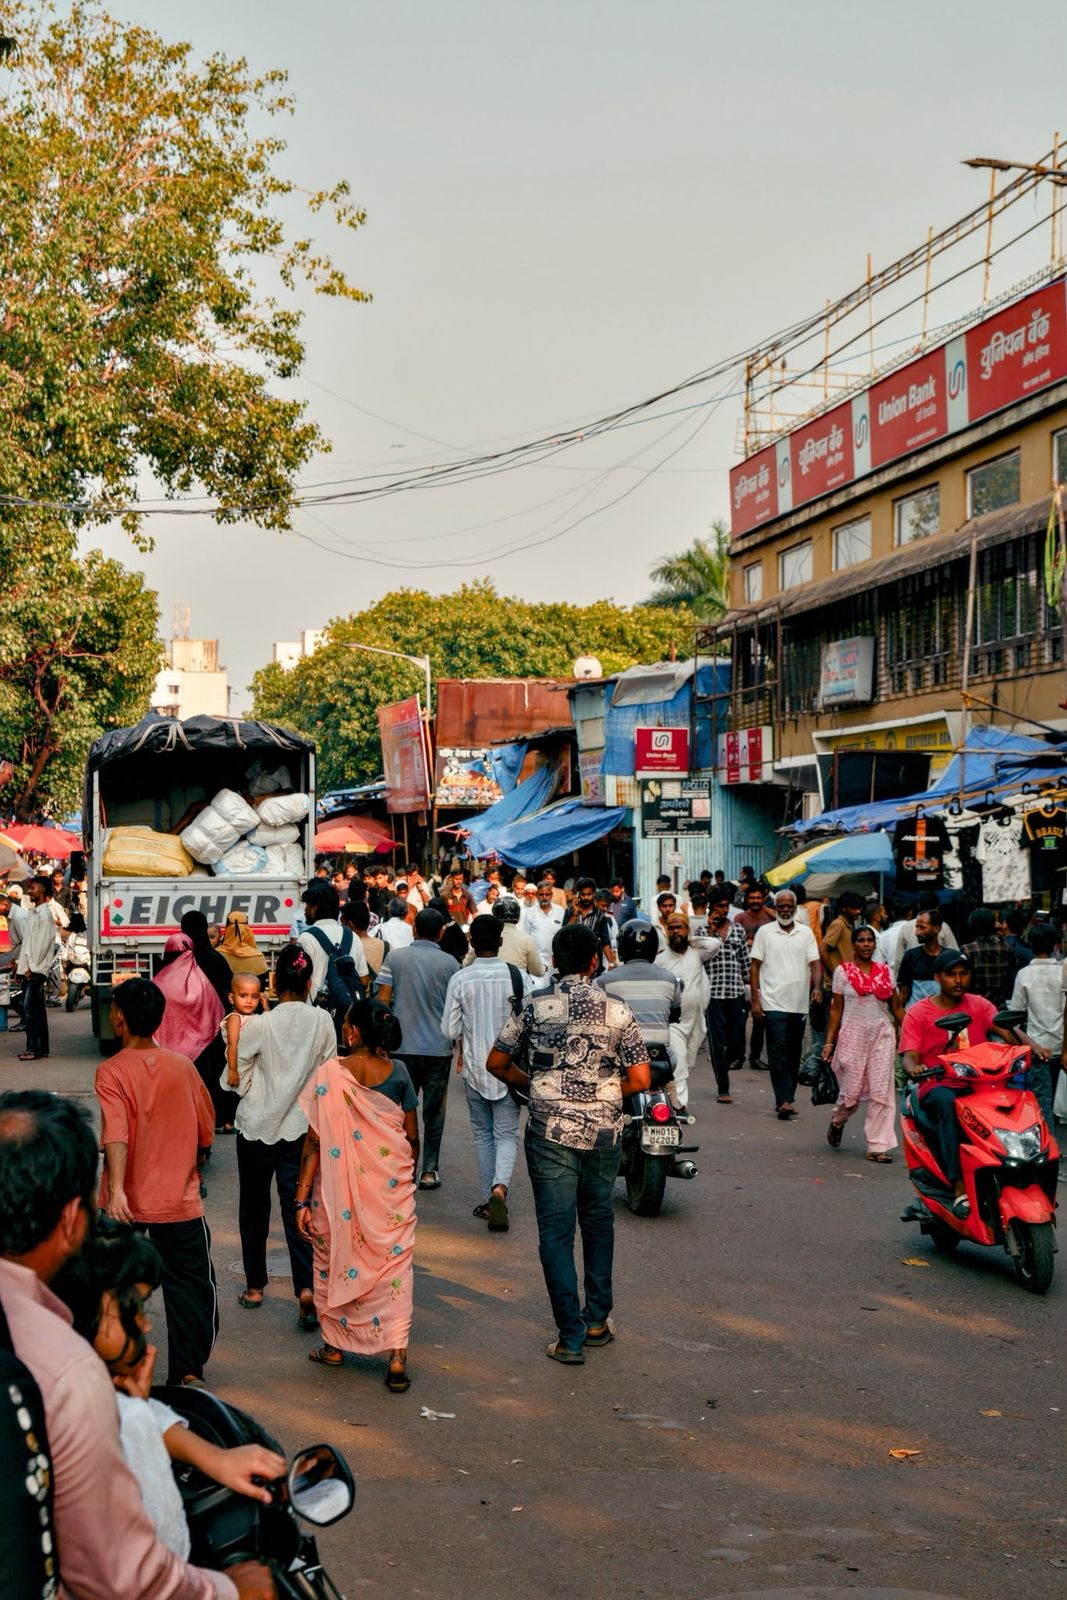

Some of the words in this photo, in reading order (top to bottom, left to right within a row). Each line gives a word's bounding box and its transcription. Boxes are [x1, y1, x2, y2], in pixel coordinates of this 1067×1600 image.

[878, 395, 907, 426] Union
[908, 374, 937, 411] Bank
[650, 1127, 676, 1137] MH01E
